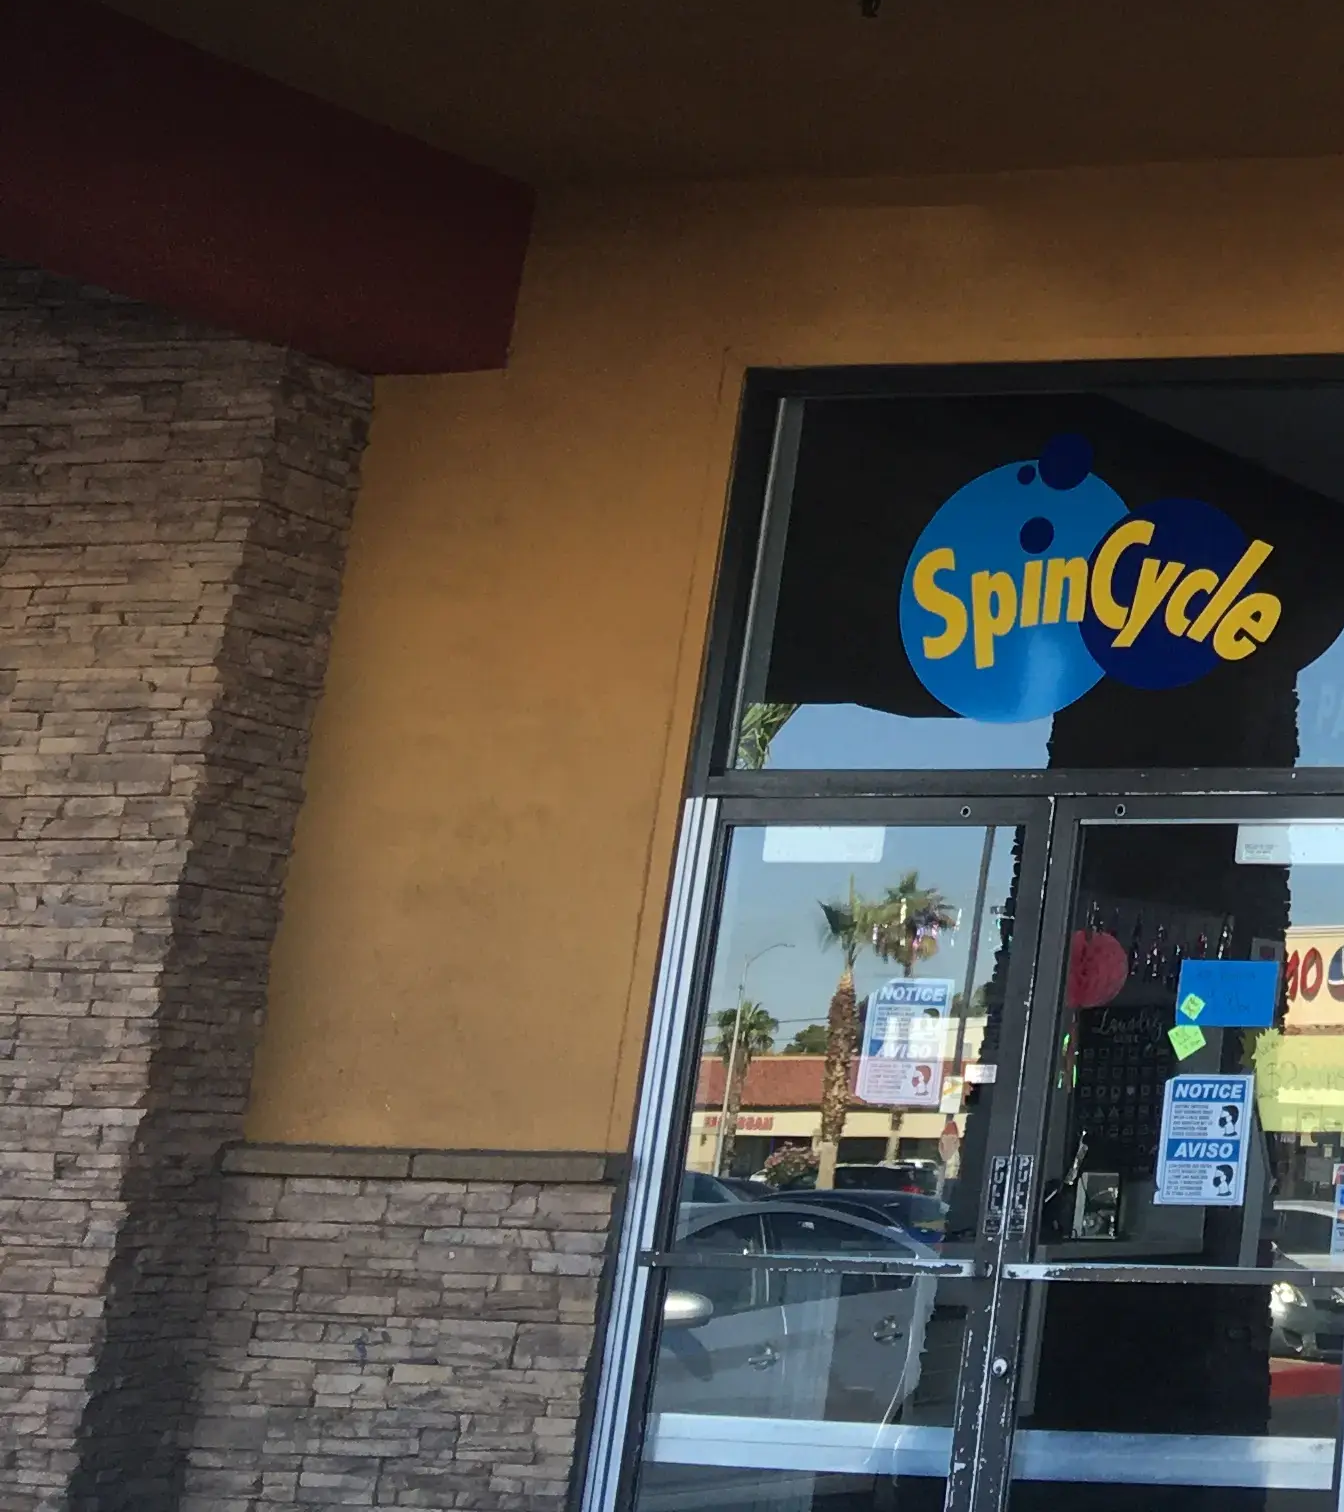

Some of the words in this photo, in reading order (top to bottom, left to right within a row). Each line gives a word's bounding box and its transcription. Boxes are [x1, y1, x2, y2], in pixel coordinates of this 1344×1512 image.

[879, 986, 946, 1002] NOTICE
[1175, 1083, 1243, 1099] NOTICE
[1173, 1141, 1234, 1159] AVISO
